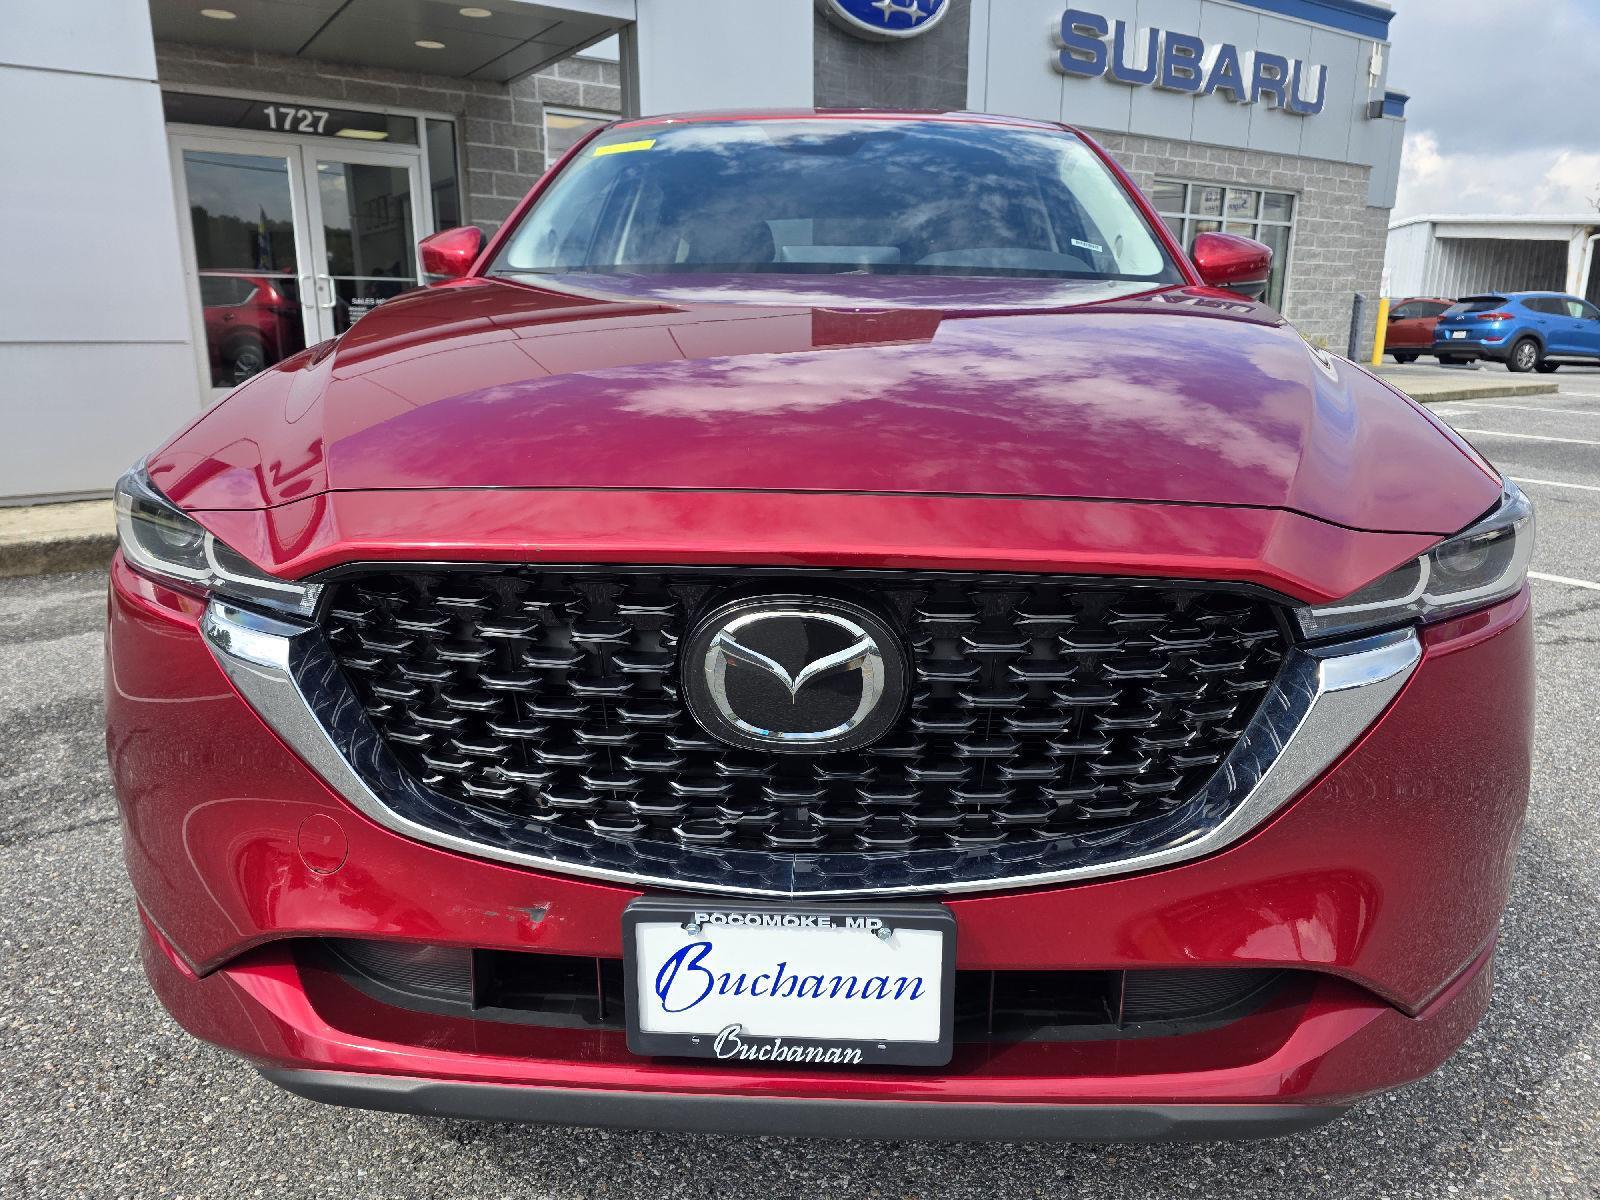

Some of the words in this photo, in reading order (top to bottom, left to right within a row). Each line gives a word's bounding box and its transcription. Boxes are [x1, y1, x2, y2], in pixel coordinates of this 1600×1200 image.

[1056, 9, 1328, 115] SUBARU
[263, 106, 330, 134] 1727
[351, 297, 375, 305] SALES
[694, 912, 837, 929] POCOMOKE,
[845, 917, 883, 929] MD
[655, 941, 926, 1013] Buchanan
[713, 1023, 864, 1064] Buchanan
